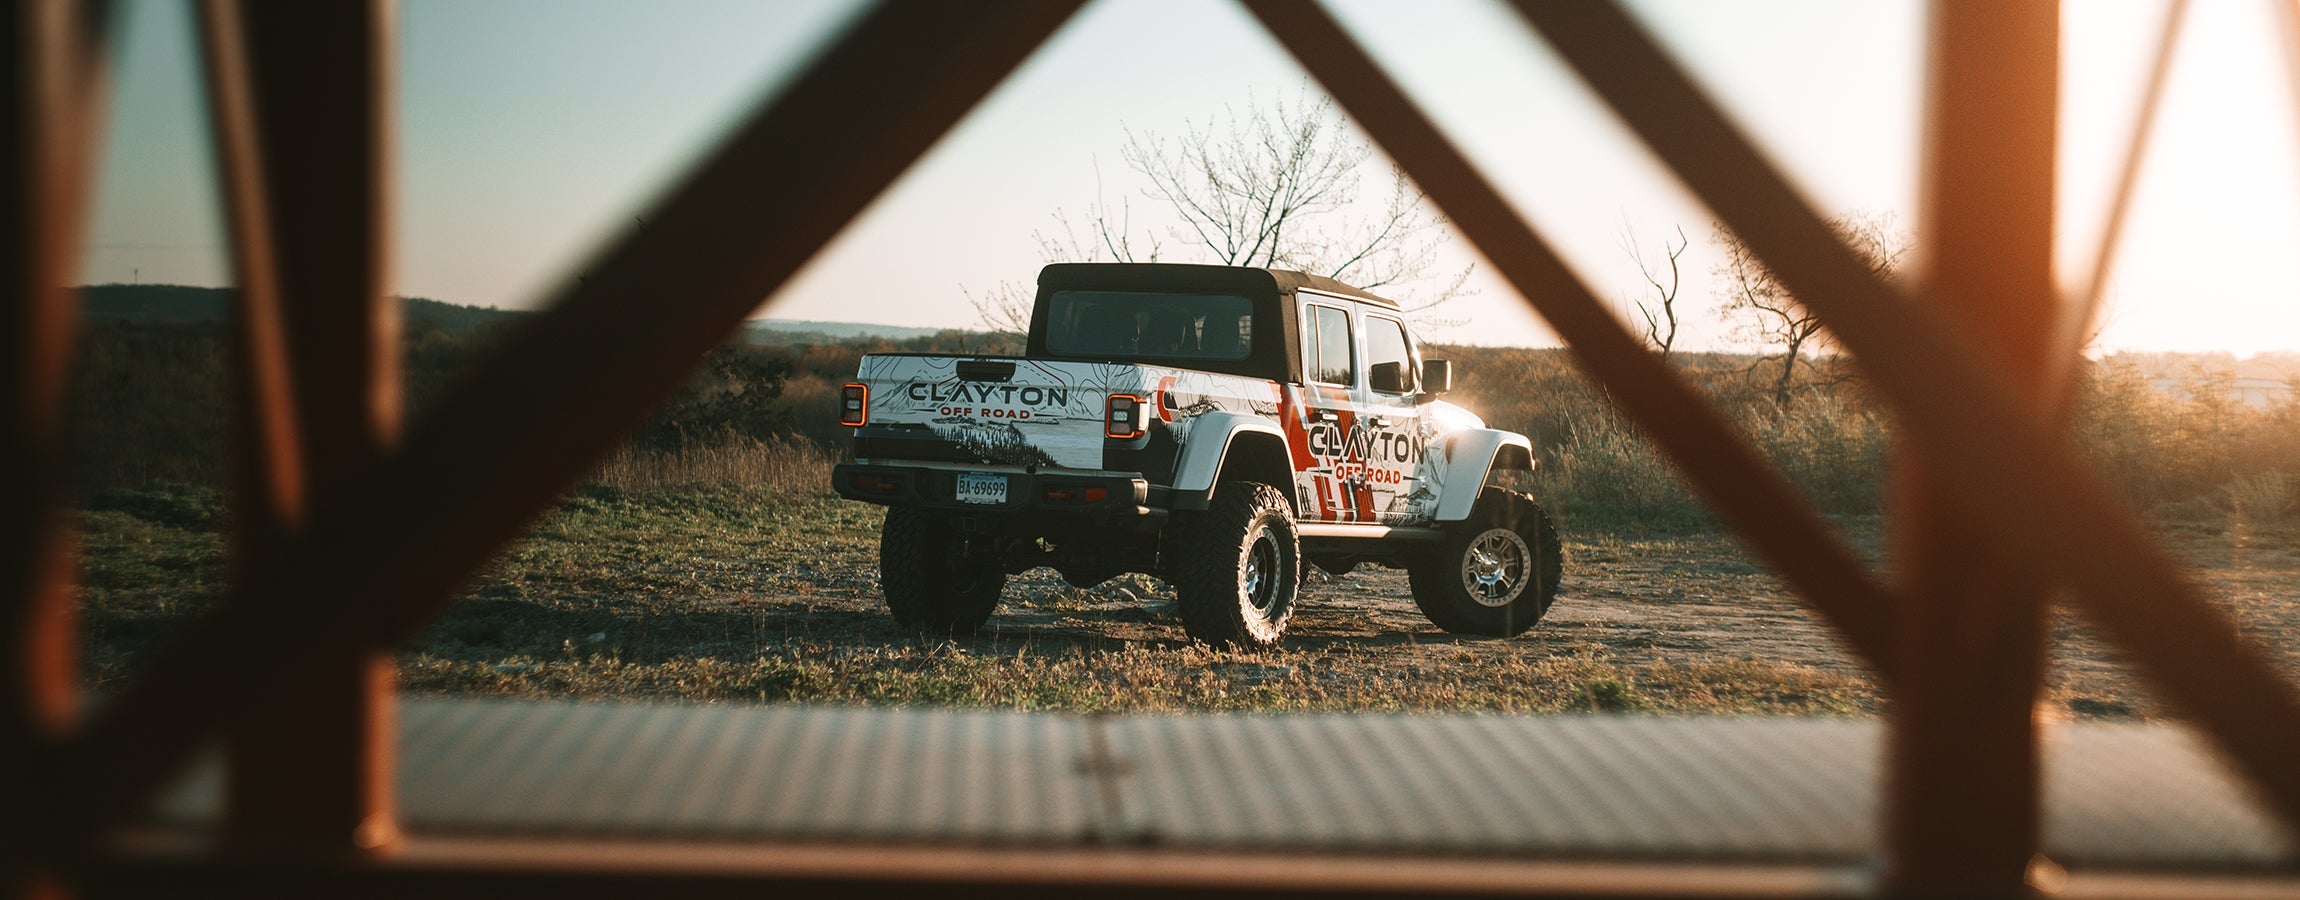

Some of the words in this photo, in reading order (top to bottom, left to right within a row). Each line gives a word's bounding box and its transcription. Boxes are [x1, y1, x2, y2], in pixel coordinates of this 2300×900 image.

[908, 383, 1068, 407] CLAYTON
[941, 407, 972, 416] OFF
[981, 409, 1030, 419] ROAD
[1309, 426, 1425, 464] CLAYTON
[1366, 468, 1401, 484] ROAD
